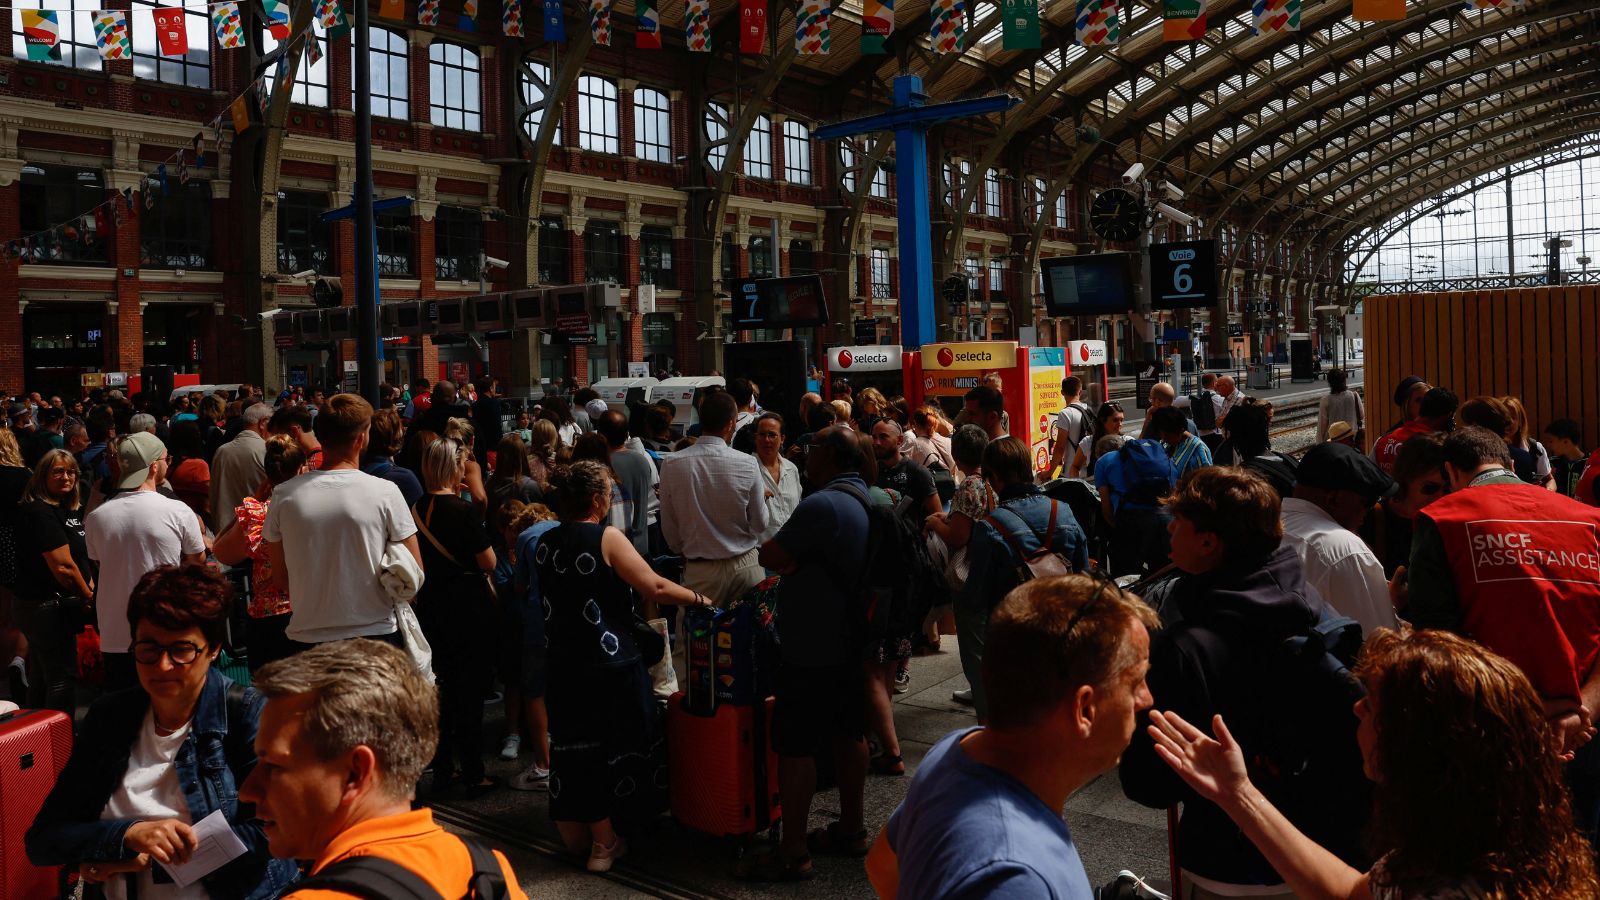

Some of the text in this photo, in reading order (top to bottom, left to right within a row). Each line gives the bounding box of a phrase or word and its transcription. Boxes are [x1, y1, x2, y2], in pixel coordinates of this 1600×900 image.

[1171, 250, 1192, 260] Voie
[1173, 263, 1193, 293] 6
[745, 294, 759, 318] 7
[853, 353, 888, 363] selecta
[955, 351, 992, 363] selecta
[924, 377, 935, 390] ICI
[938, 378, 954, 388] PRIX
[1039, 391, 1059, 400] saveurs
[1473, 533, 1532, 551] SNCF
[1477, 549, 1599, 571] ASSISTANCE
[691, 640, 708, 651] FRAIS
